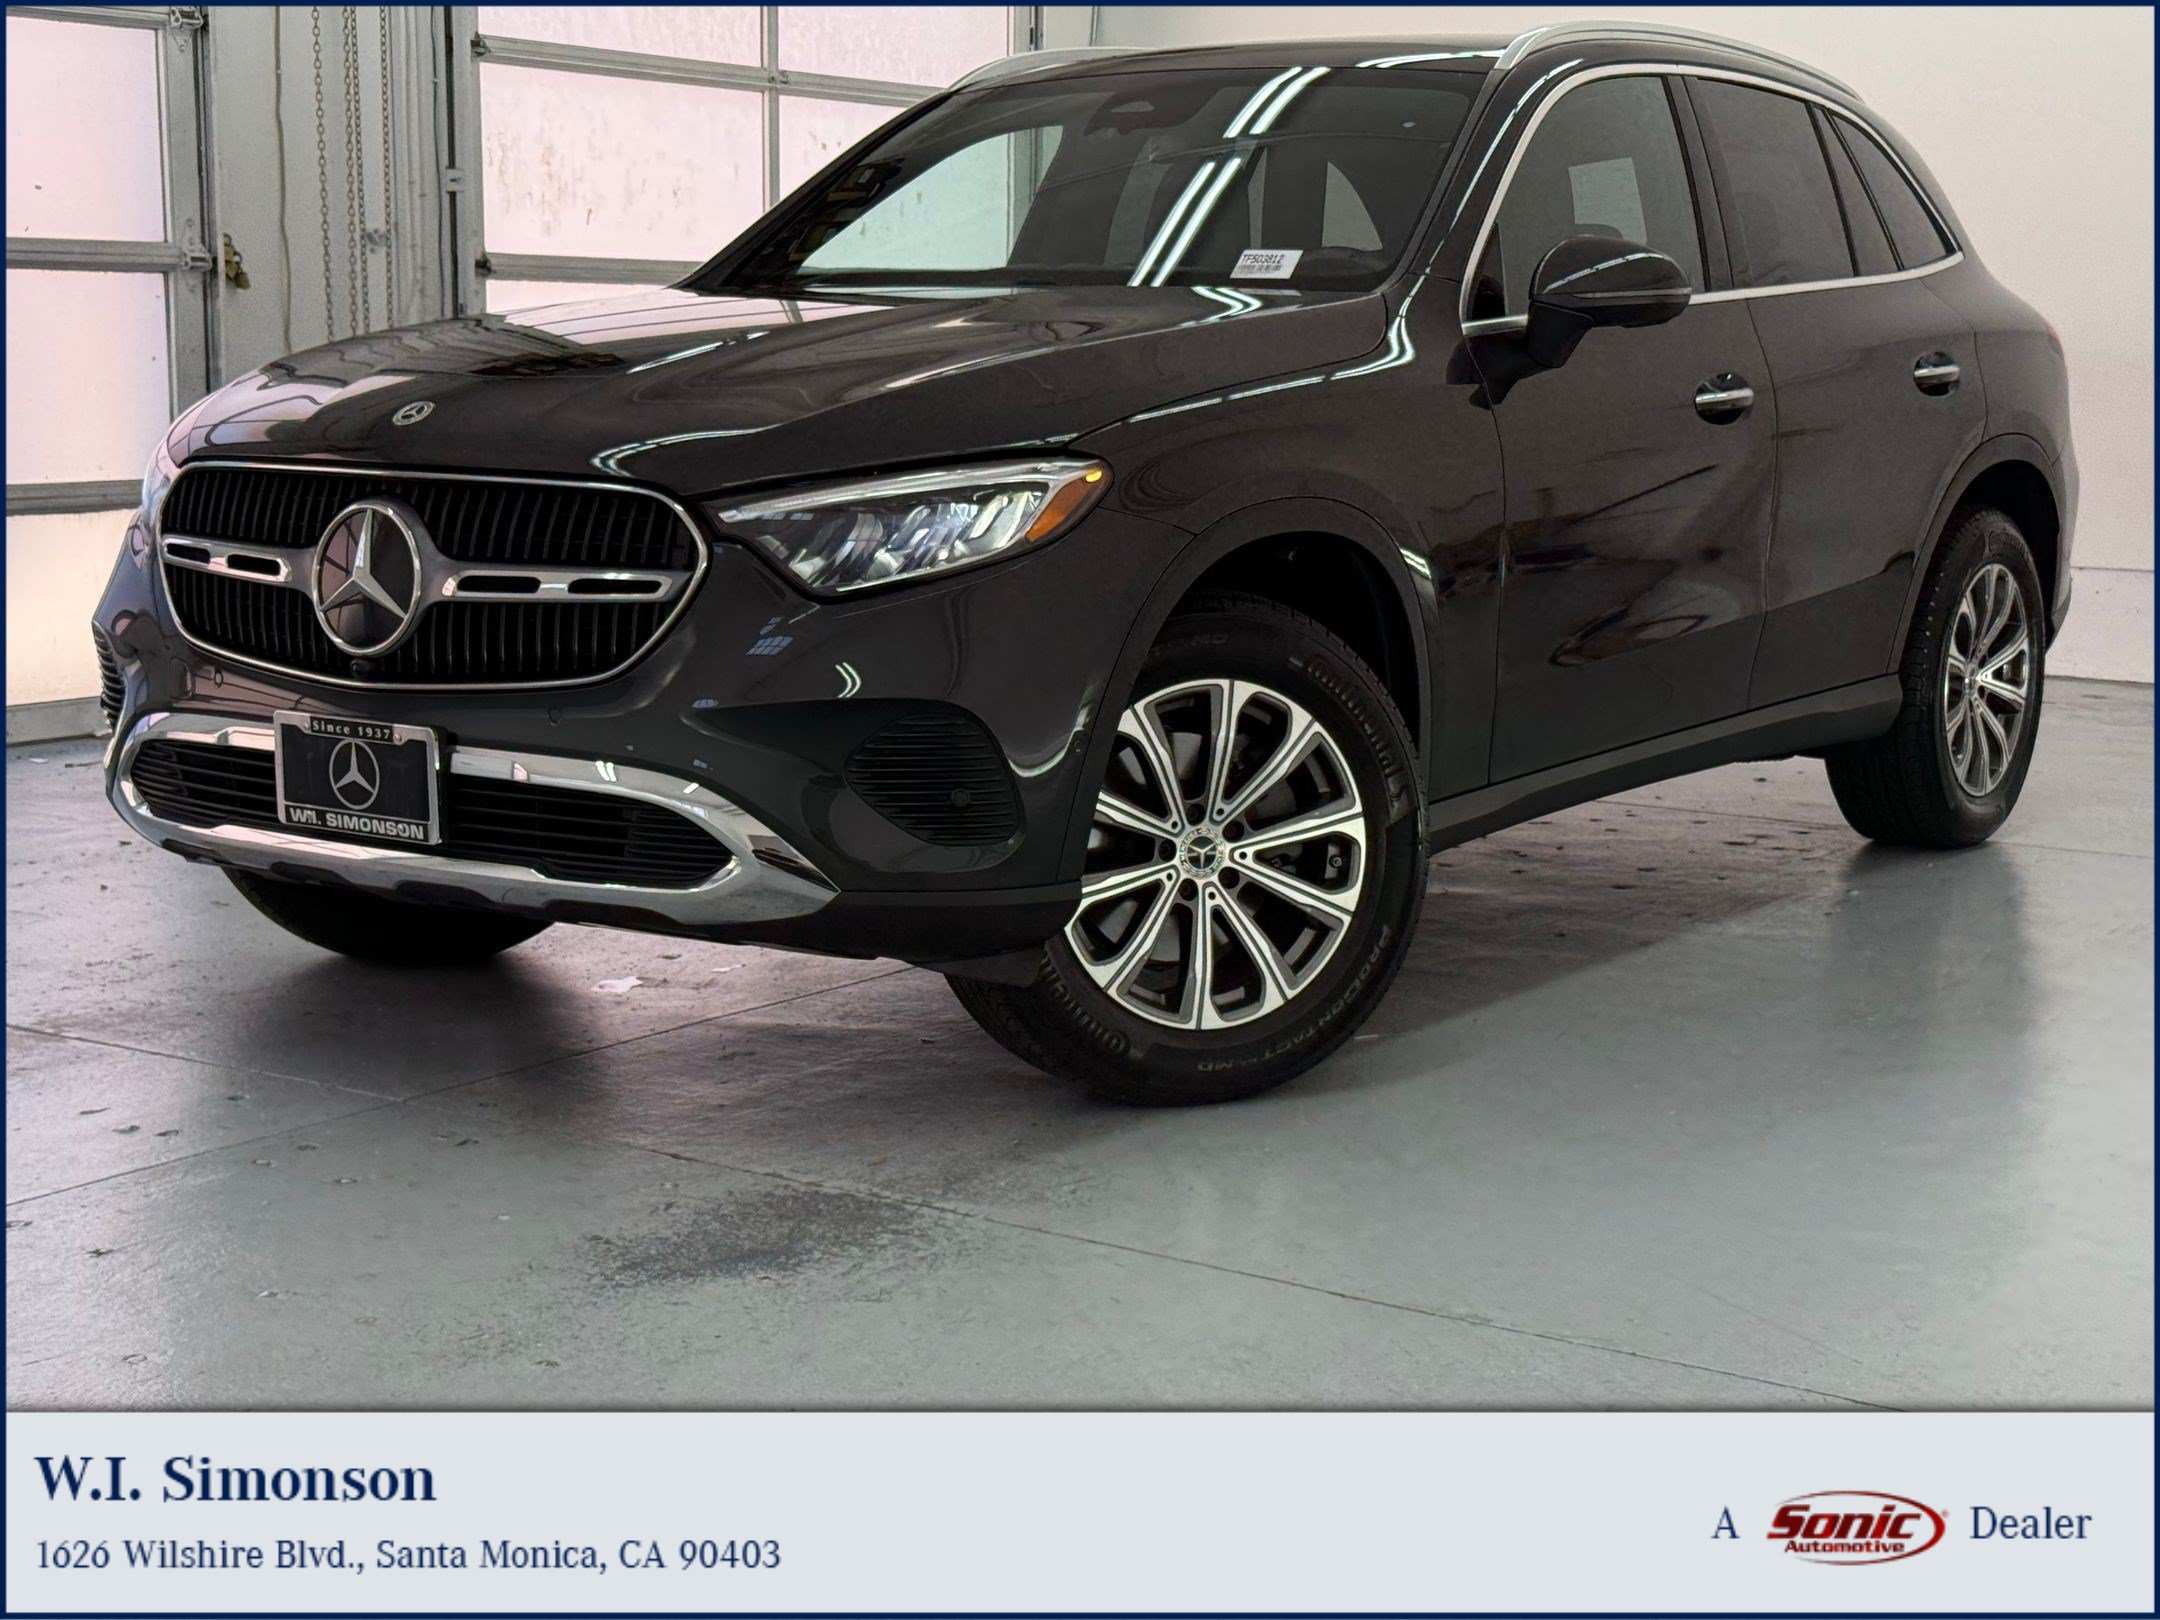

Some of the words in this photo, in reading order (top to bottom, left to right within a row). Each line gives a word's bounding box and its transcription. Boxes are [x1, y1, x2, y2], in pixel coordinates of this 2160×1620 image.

[312, 720, 351, 734] Since
[357, 726, 391, 739] 1937
[325, 812, 425, 840] SIMONSON
